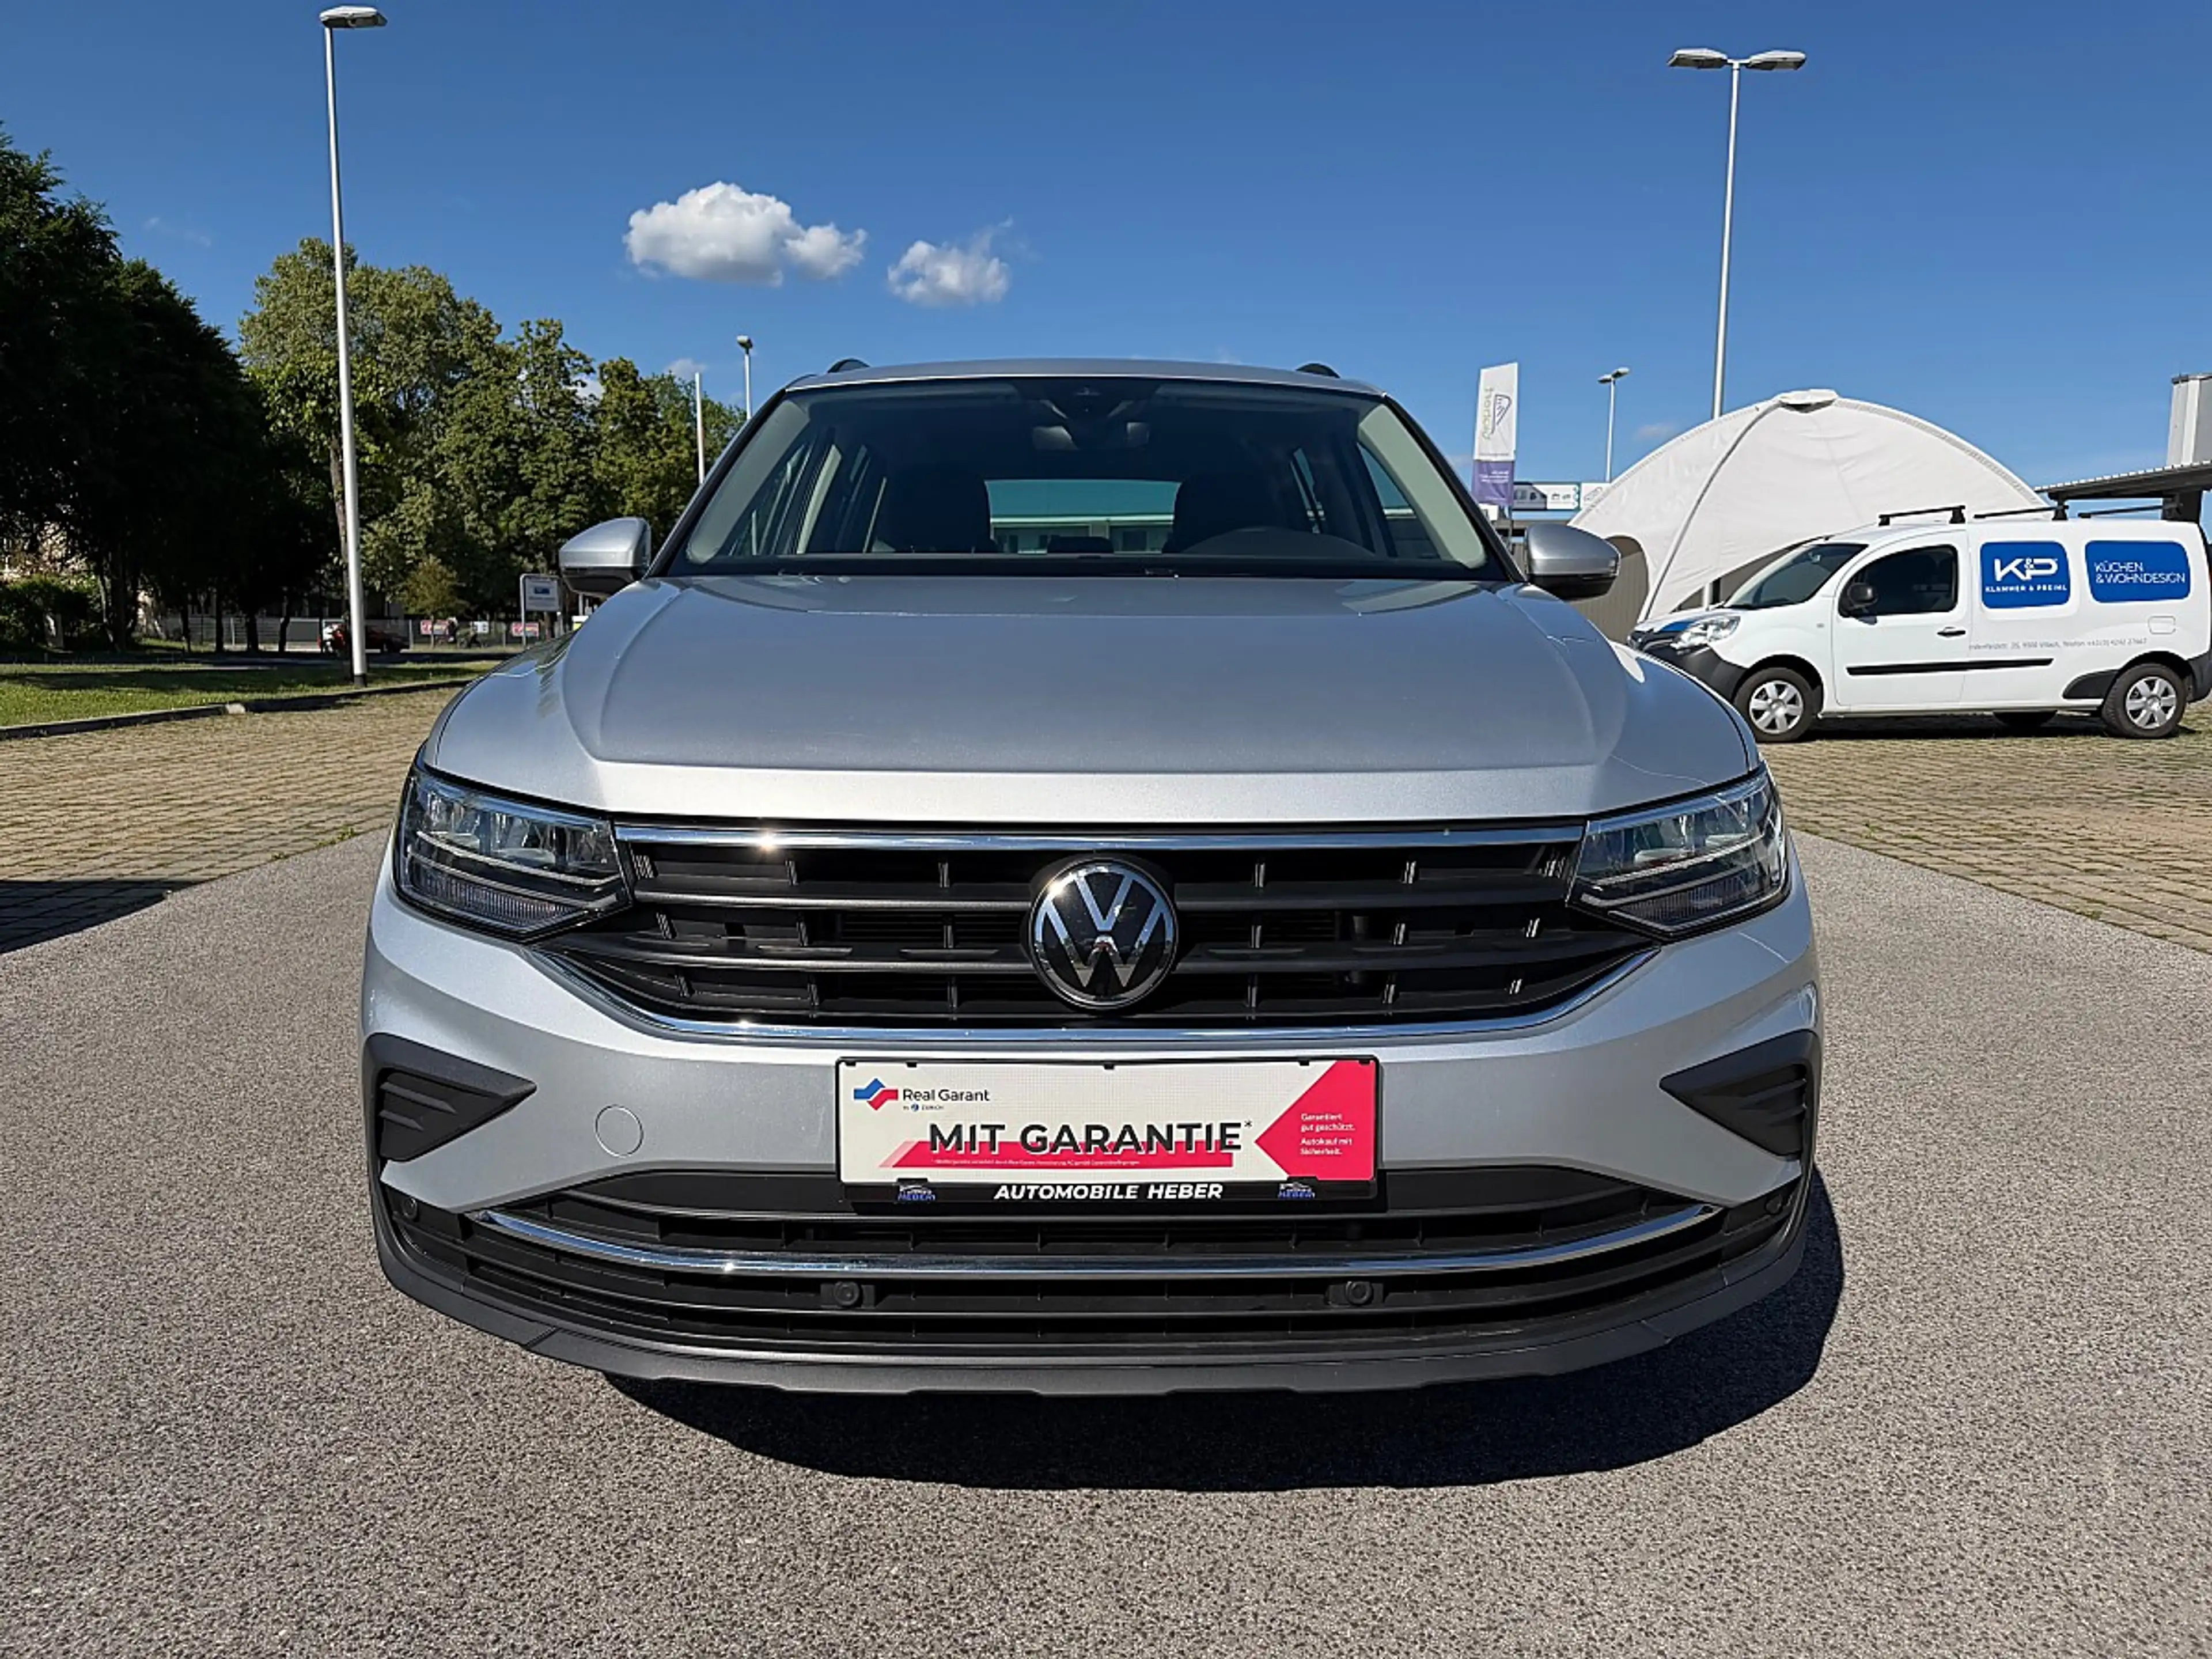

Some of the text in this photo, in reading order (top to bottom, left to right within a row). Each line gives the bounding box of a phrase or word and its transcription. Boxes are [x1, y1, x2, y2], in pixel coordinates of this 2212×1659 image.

[2094, 560, 2143, 572] KÜCHEN
[2105, 573, 2186, 583] WOHNDESIGN
[903, 1089, 990, 1101] Real Garant
[930, 1123, 1006, 1153] MIT
[994, 1183, 1224, 1200] AUTOMOBILE HEBER
